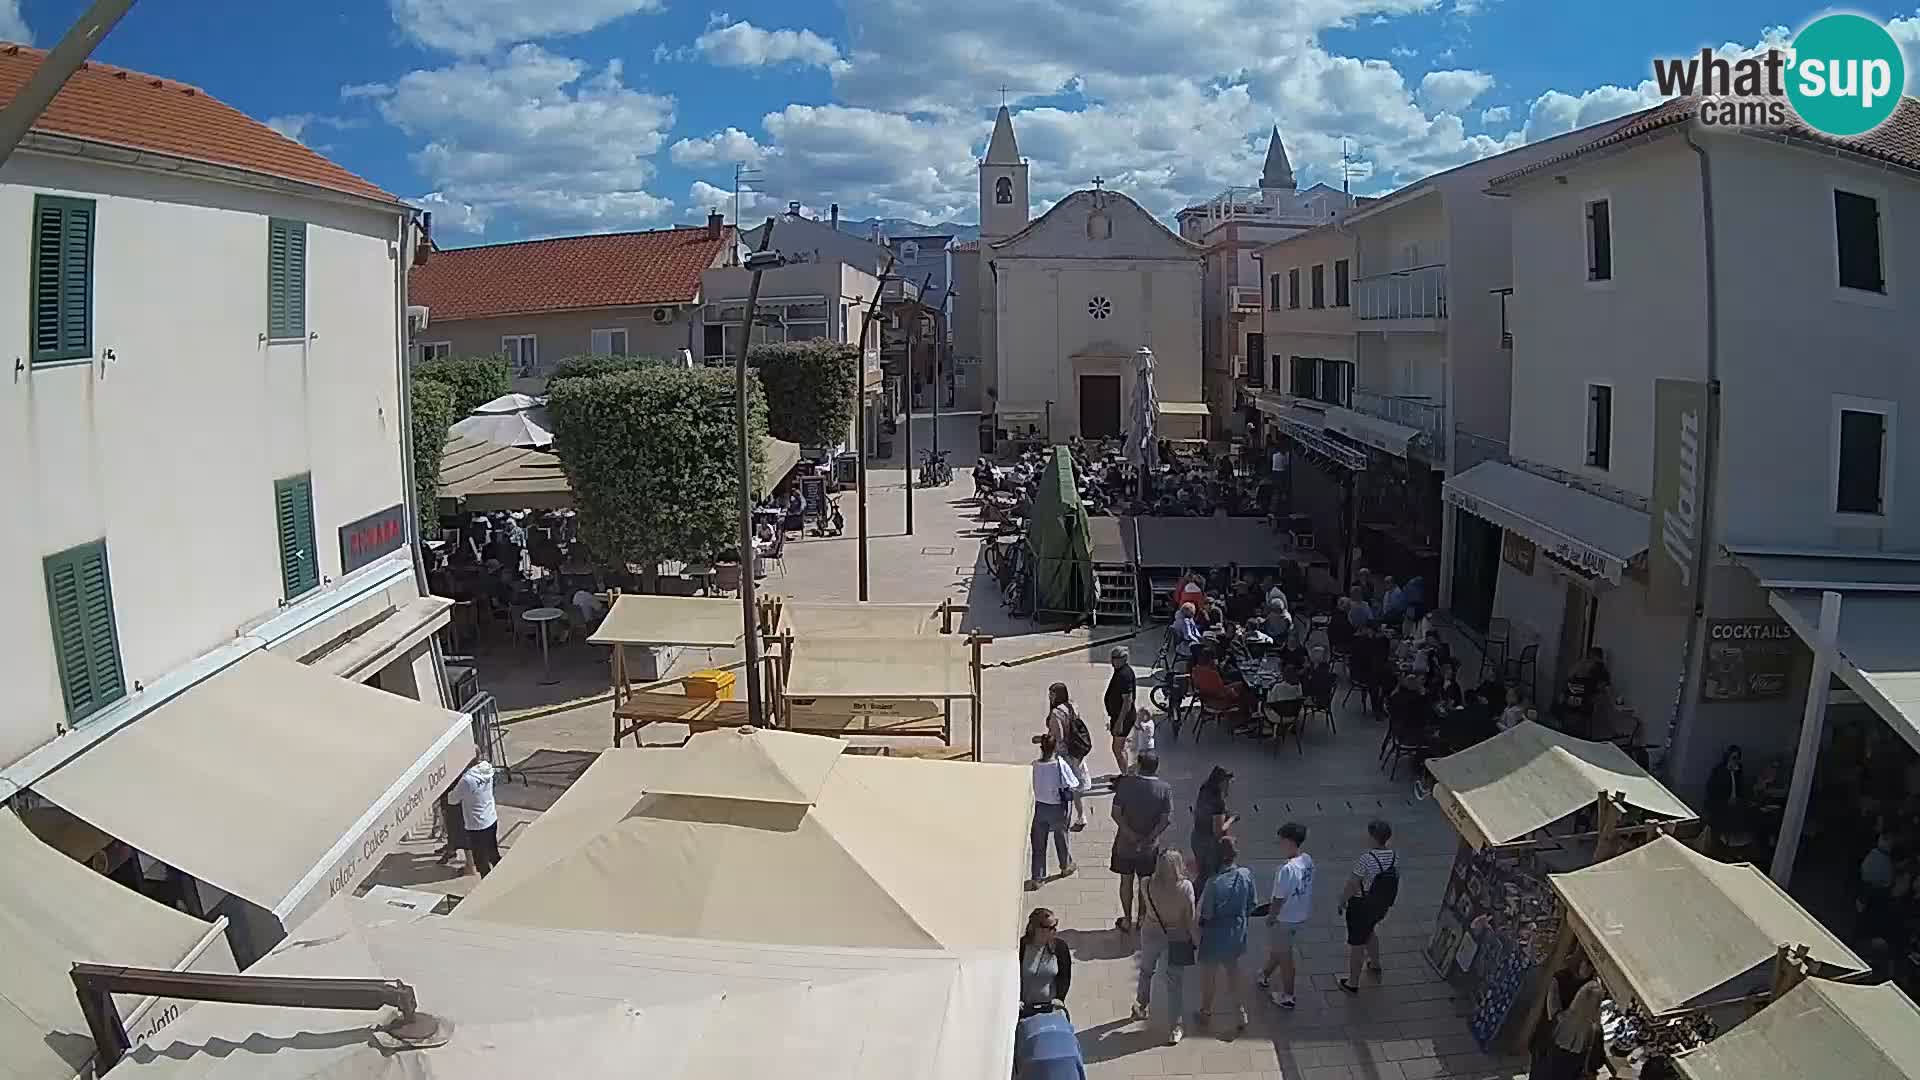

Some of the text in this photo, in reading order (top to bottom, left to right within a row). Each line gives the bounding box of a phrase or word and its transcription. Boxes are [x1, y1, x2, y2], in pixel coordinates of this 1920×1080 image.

[1711, 624, 1792, 639] COCKTAILS
[363, 824, 389, 861] Cakes
[395, 787, 424, 826] Kuchen
